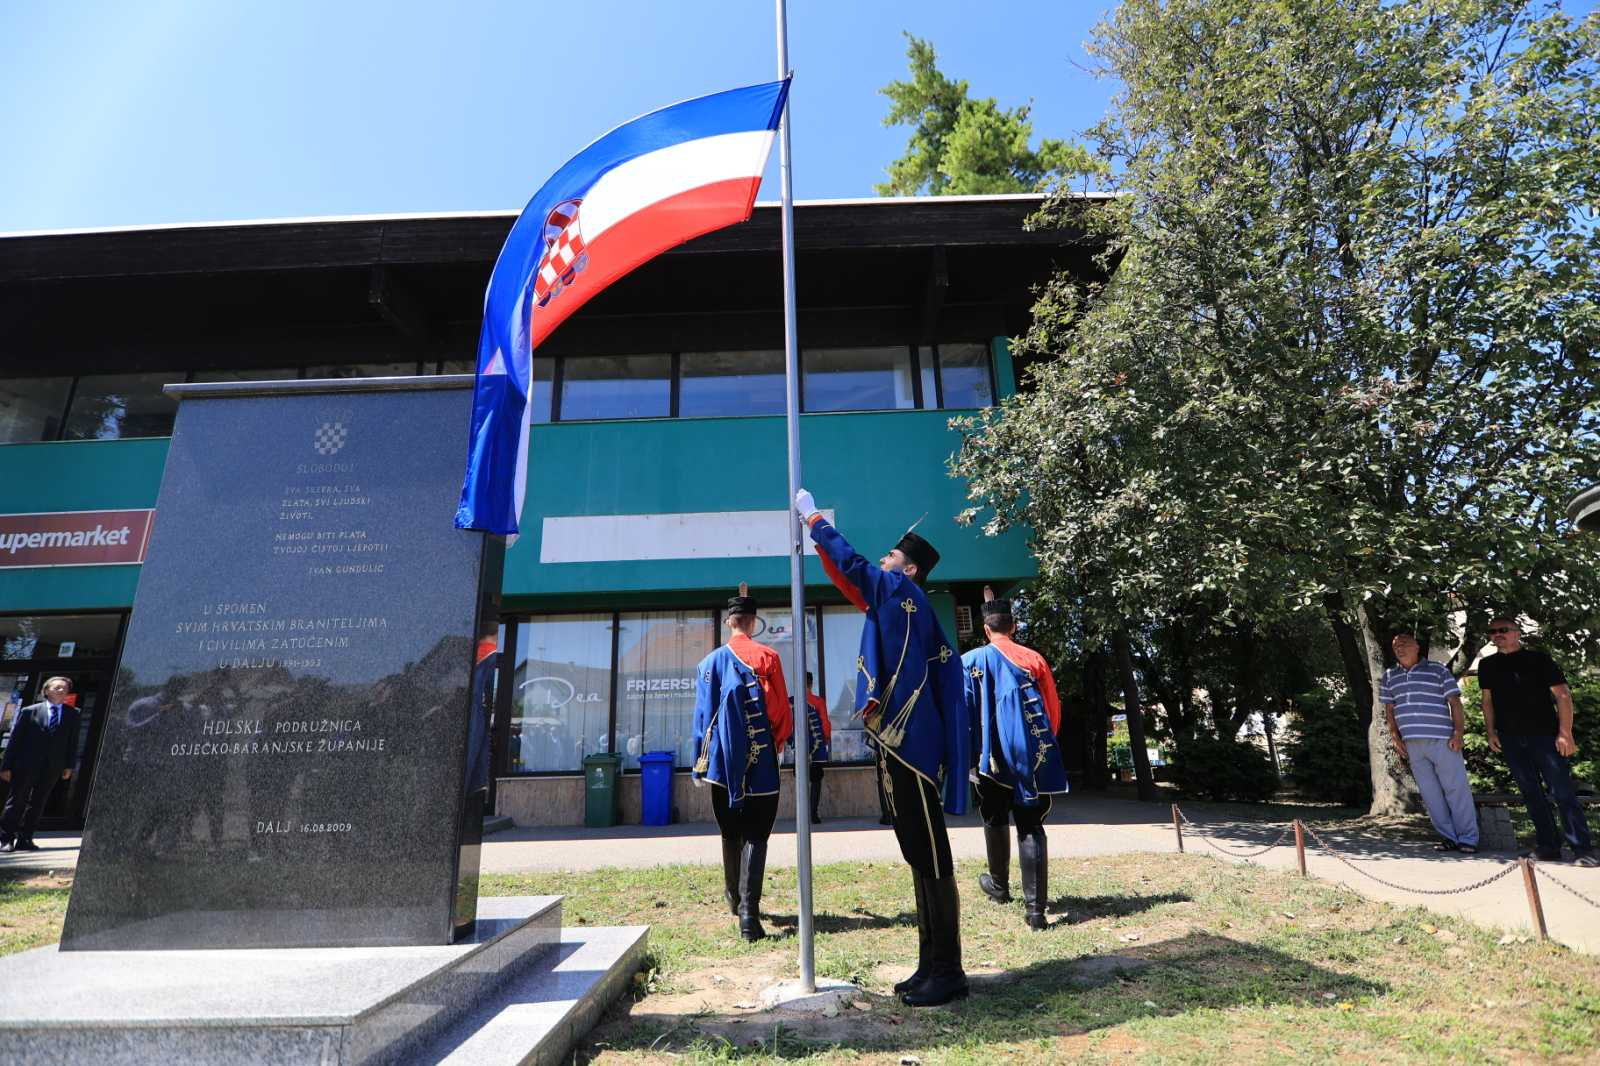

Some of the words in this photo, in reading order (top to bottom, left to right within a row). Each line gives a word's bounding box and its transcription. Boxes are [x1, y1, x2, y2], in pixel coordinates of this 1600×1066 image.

[204, 605, 211, 615] U
[216, 603, 266, 615] SPOMEN
[176, 622, 208, 633] SVIM
[212, 619, 286, 632] HRVATSKIM
[289, 617, 387, 630] BRANITELJIMA
[207, 638, 266, 651] CIVILIMA
[219, 659, 227, 669] U
[231, 657, 275, 669] DALJU
[275, 719, 362, 734] PODRUŽNICA
[317, 739, 386, 753] ŽUPANIJE
[256, 820, 291, 834] DALJ
